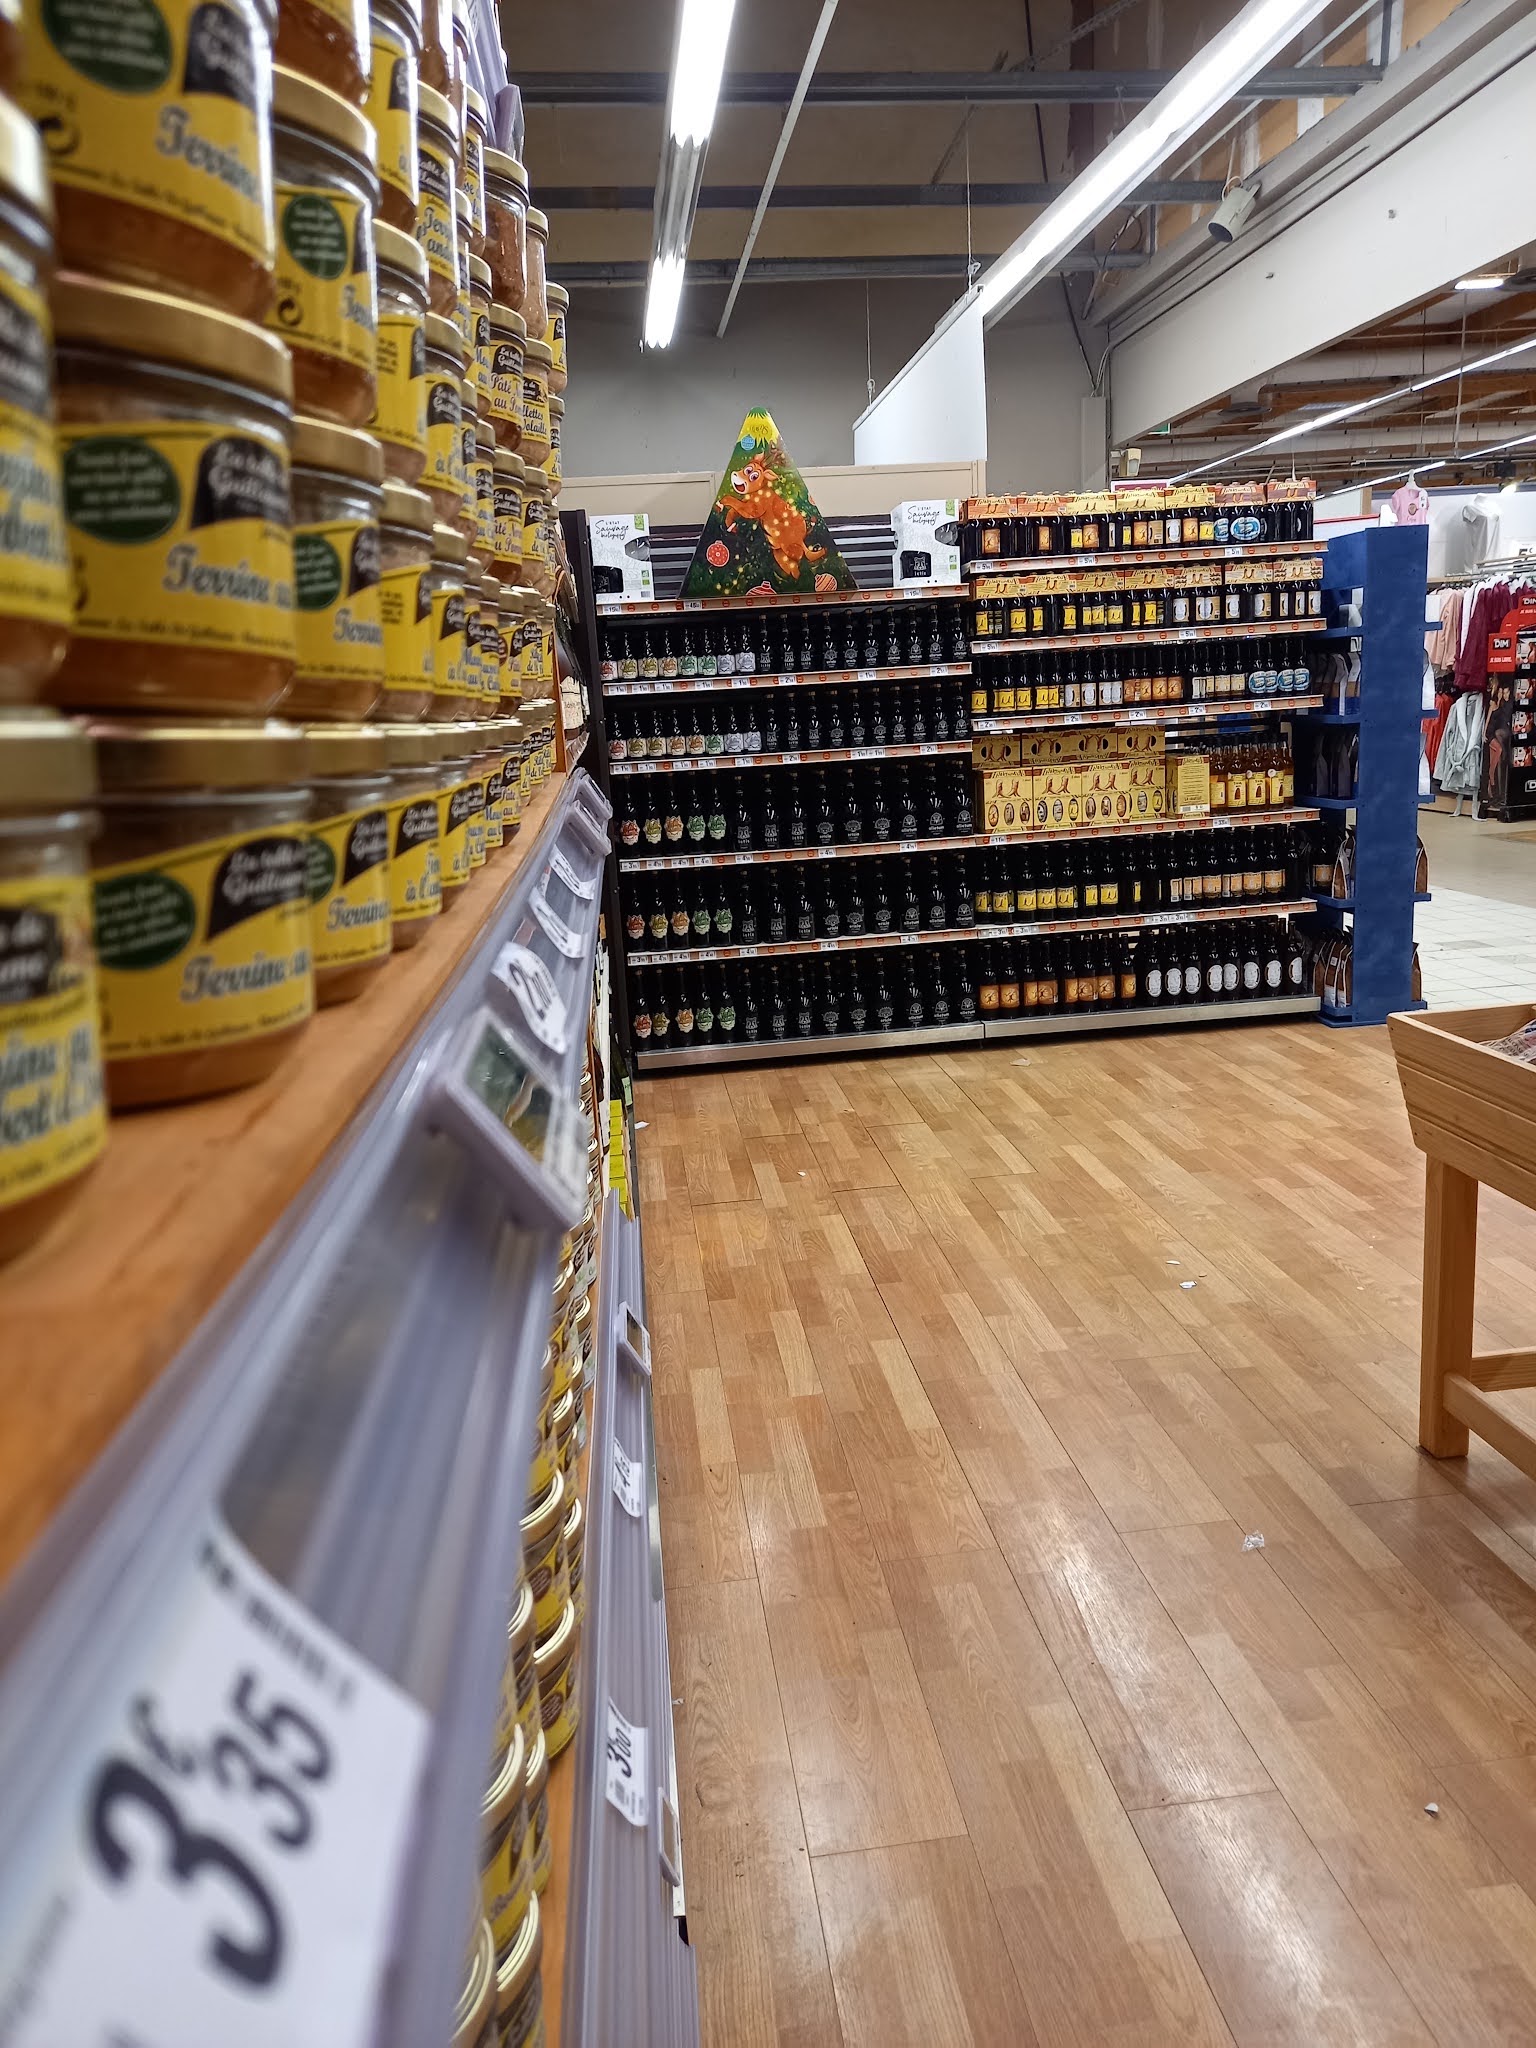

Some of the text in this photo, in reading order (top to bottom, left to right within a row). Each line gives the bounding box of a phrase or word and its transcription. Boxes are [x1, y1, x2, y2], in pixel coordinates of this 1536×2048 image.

[491, 373, 511, 394] Pâté
[494, 398, 507, 409] au
[523, 405, 543, 421] llettes
[1494, 638, 1509, 649] DIM
